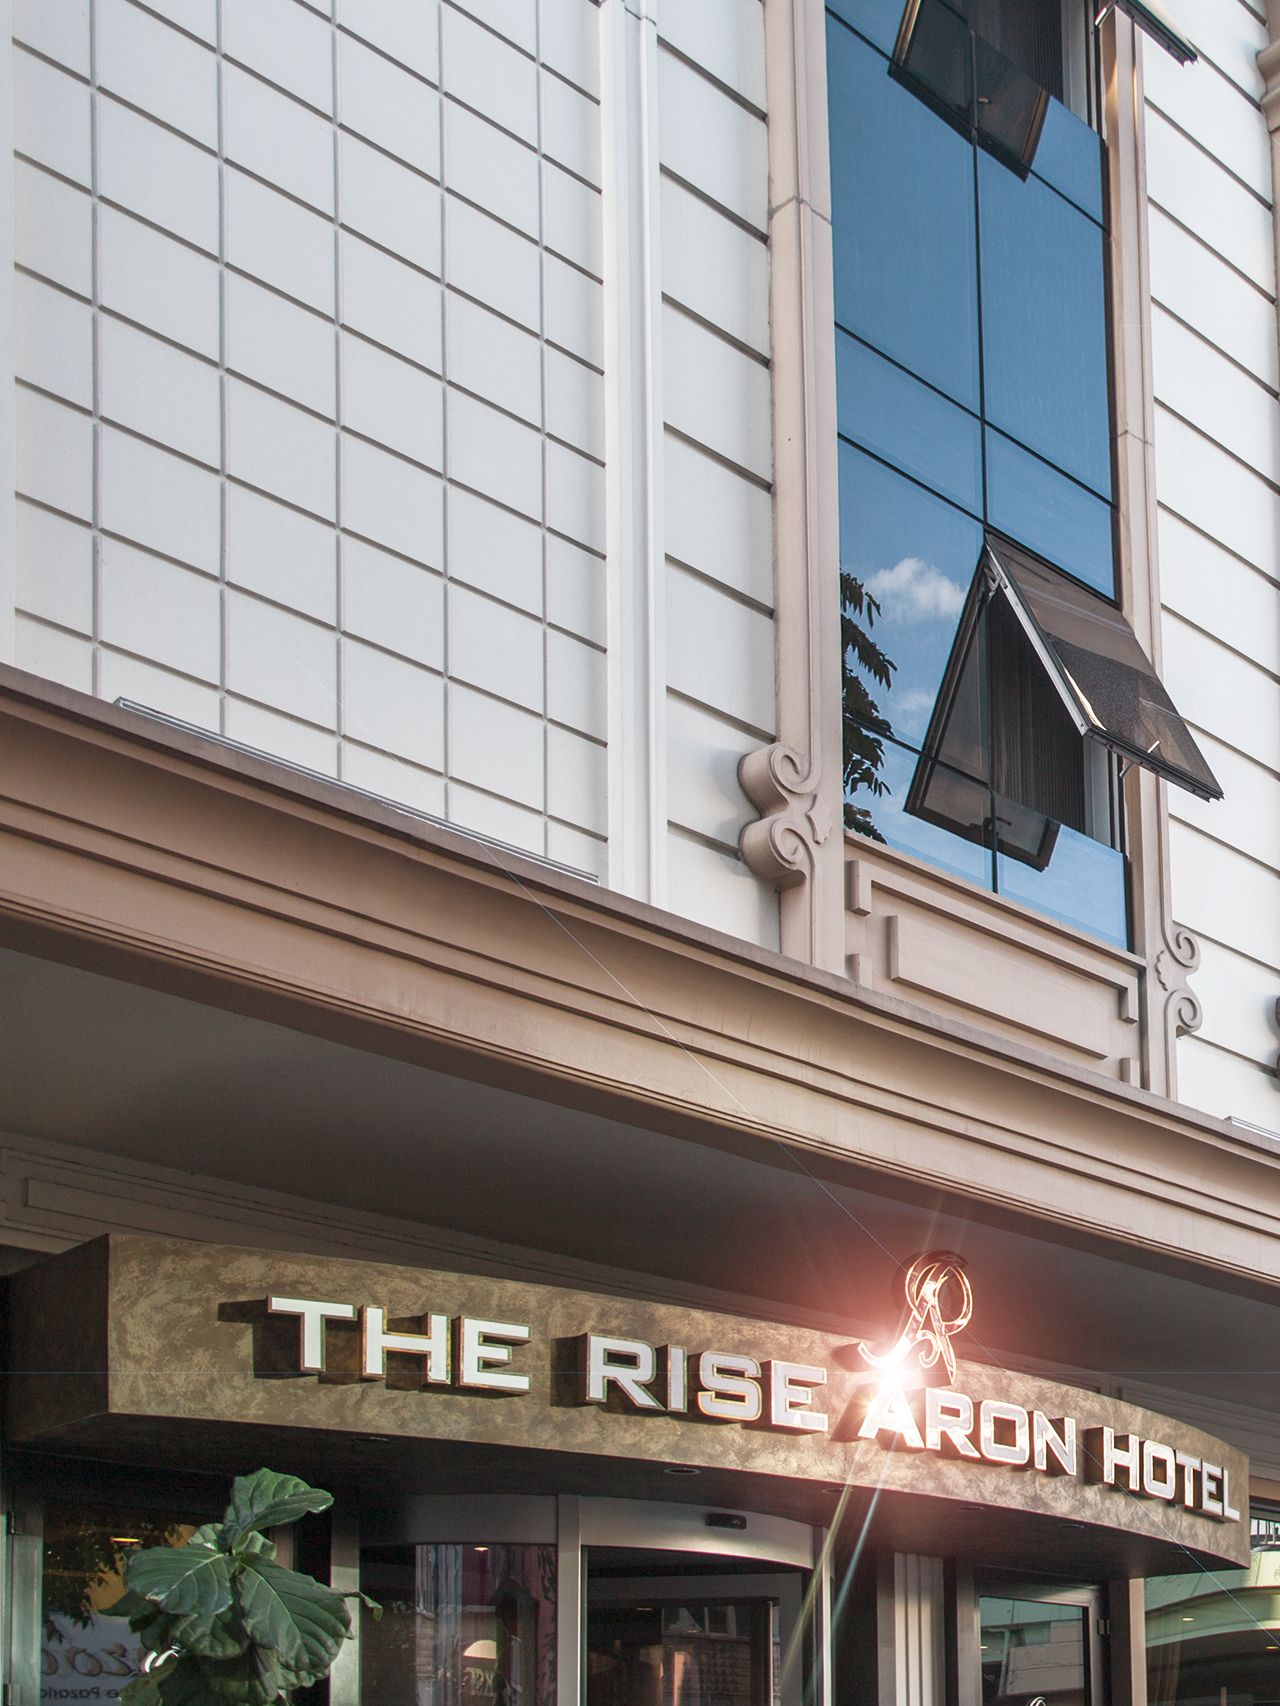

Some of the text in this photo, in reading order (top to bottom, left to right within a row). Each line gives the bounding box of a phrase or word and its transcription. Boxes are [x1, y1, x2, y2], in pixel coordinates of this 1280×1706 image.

[268, 1296, 1241, 1523] THE RISE ARON HOTEL
